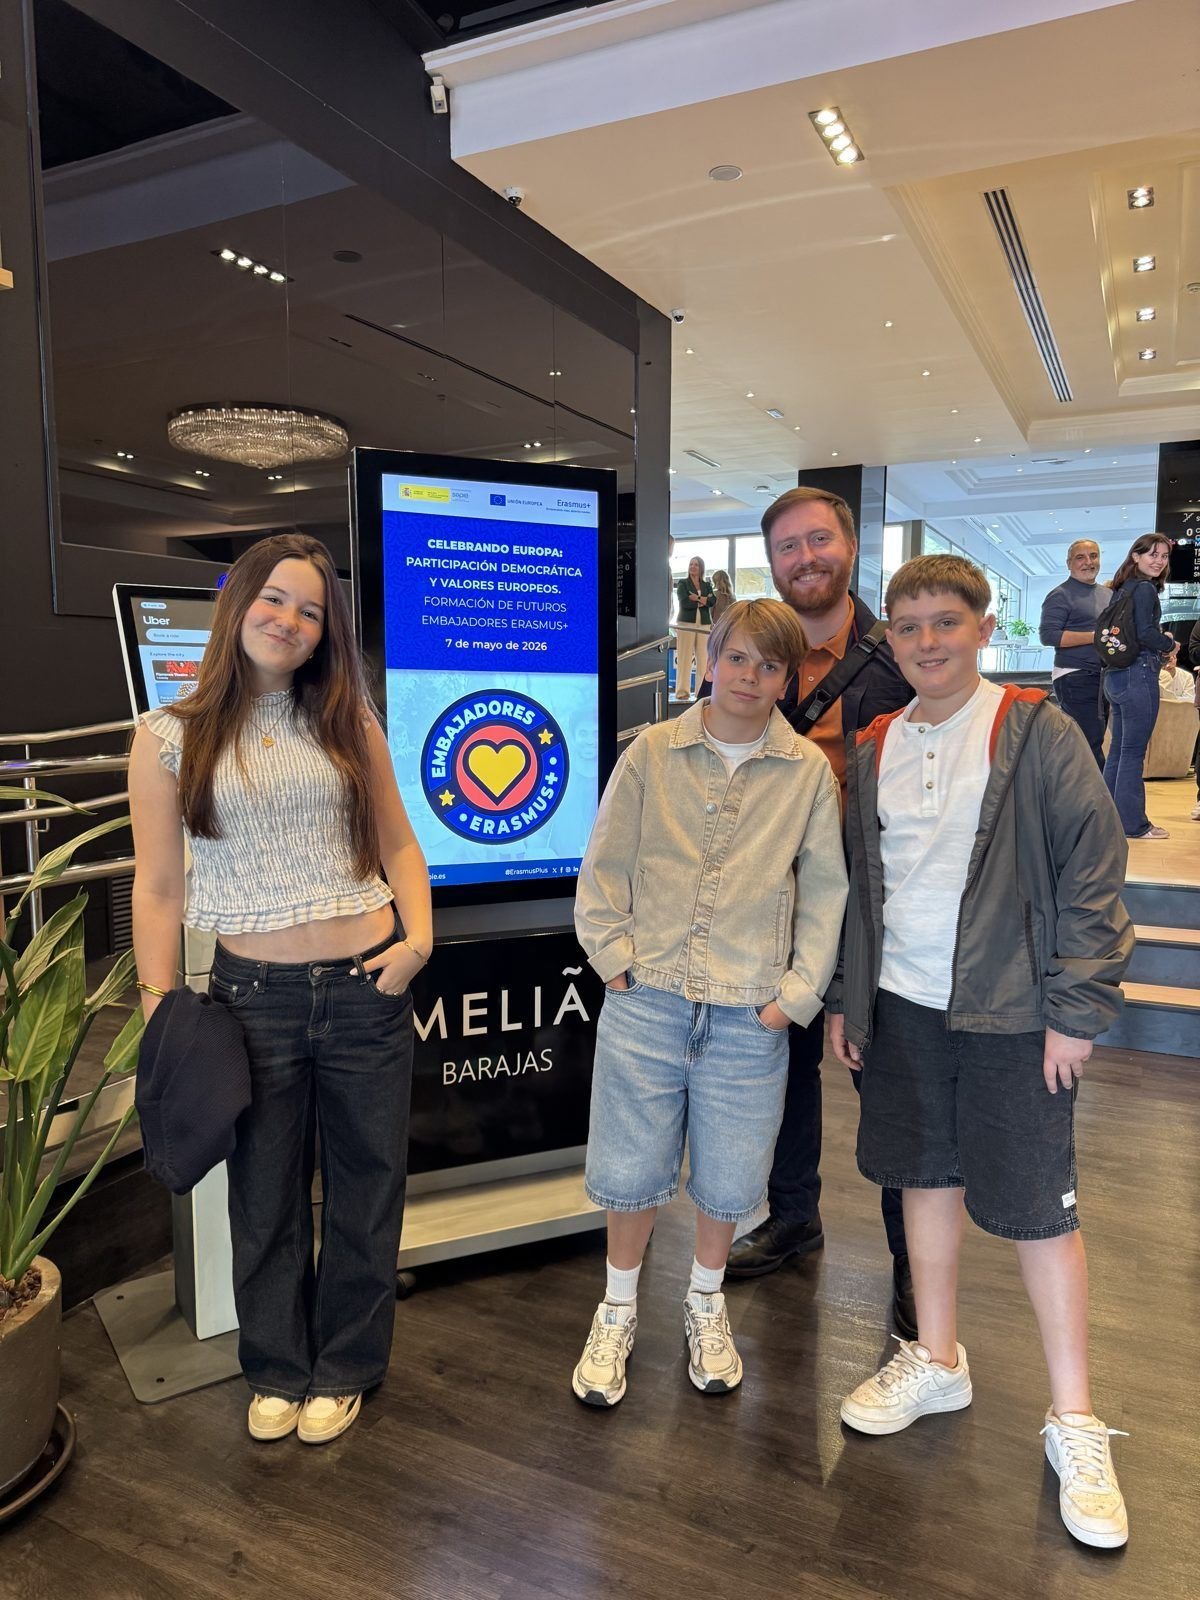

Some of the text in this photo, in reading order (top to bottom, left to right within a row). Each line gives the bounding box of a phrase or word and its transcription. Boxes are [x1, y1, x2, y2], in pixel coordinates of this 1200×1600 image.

[556, 499, 591, 509] Erasmus+
[427, 538, 563, 558] CELEBRANDO EUROPA:
[406, 556, 583, 578] PARTICIPACIÓN DEMOCRÁTICA
[429, 577, 562, 595] Y VALORES EUROPEOS.
[424, 596, 567, 613] FORMACIÓN DE FUTUROS
[142, 615, 171, 626] Uber
[422, 615, 569, 631] EMBAJADORES ERASMUS+
[445, 639, 548, 652] 7 de mayo de 2026
[431, 700, 536, 779] EMBAJADORES
[469, 771, 559, 835] ERASMUS+
[505, 867, 549, 876] #ErasmusPlus
[443, 1049, 553, 1085] BARAJAS
